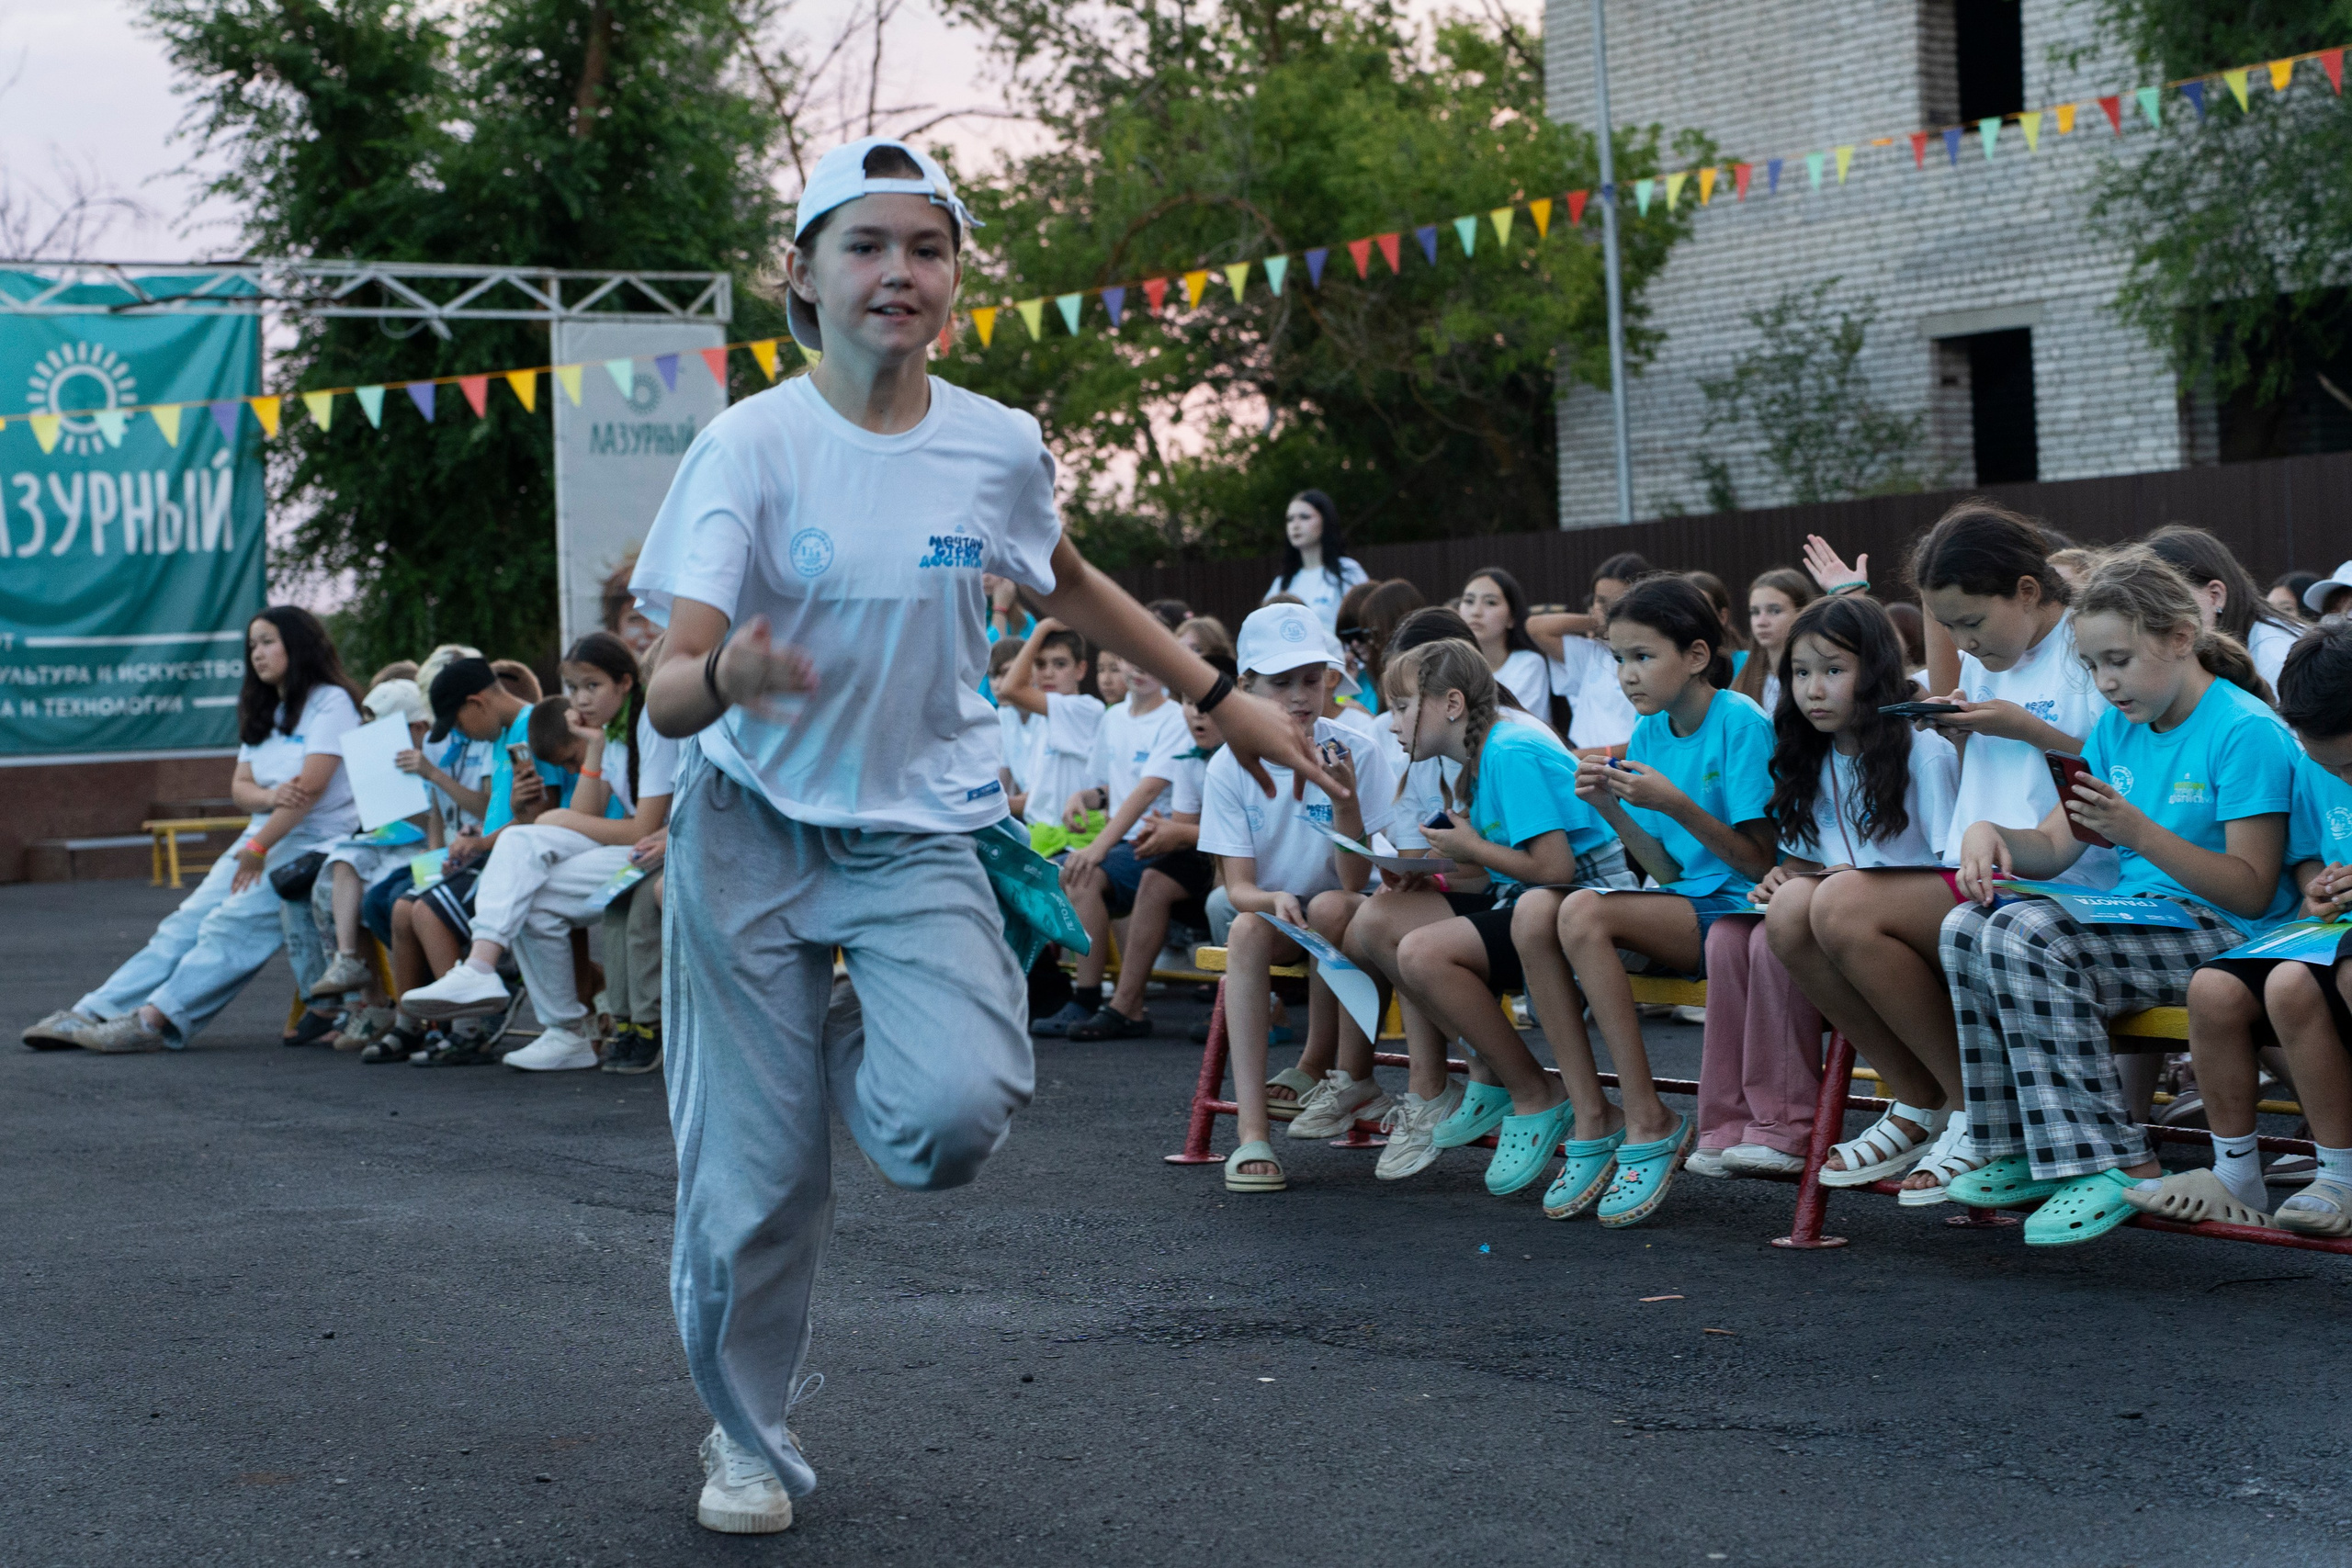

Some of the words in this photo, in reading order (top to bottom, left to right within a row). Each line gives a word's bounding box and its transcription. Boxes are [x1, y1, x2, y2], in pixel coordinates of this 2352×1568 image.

[96, 665, 112, 684] И
[117, 659, 245, 683] ИСКУССТВО
[21, 697, 38, 717] И
